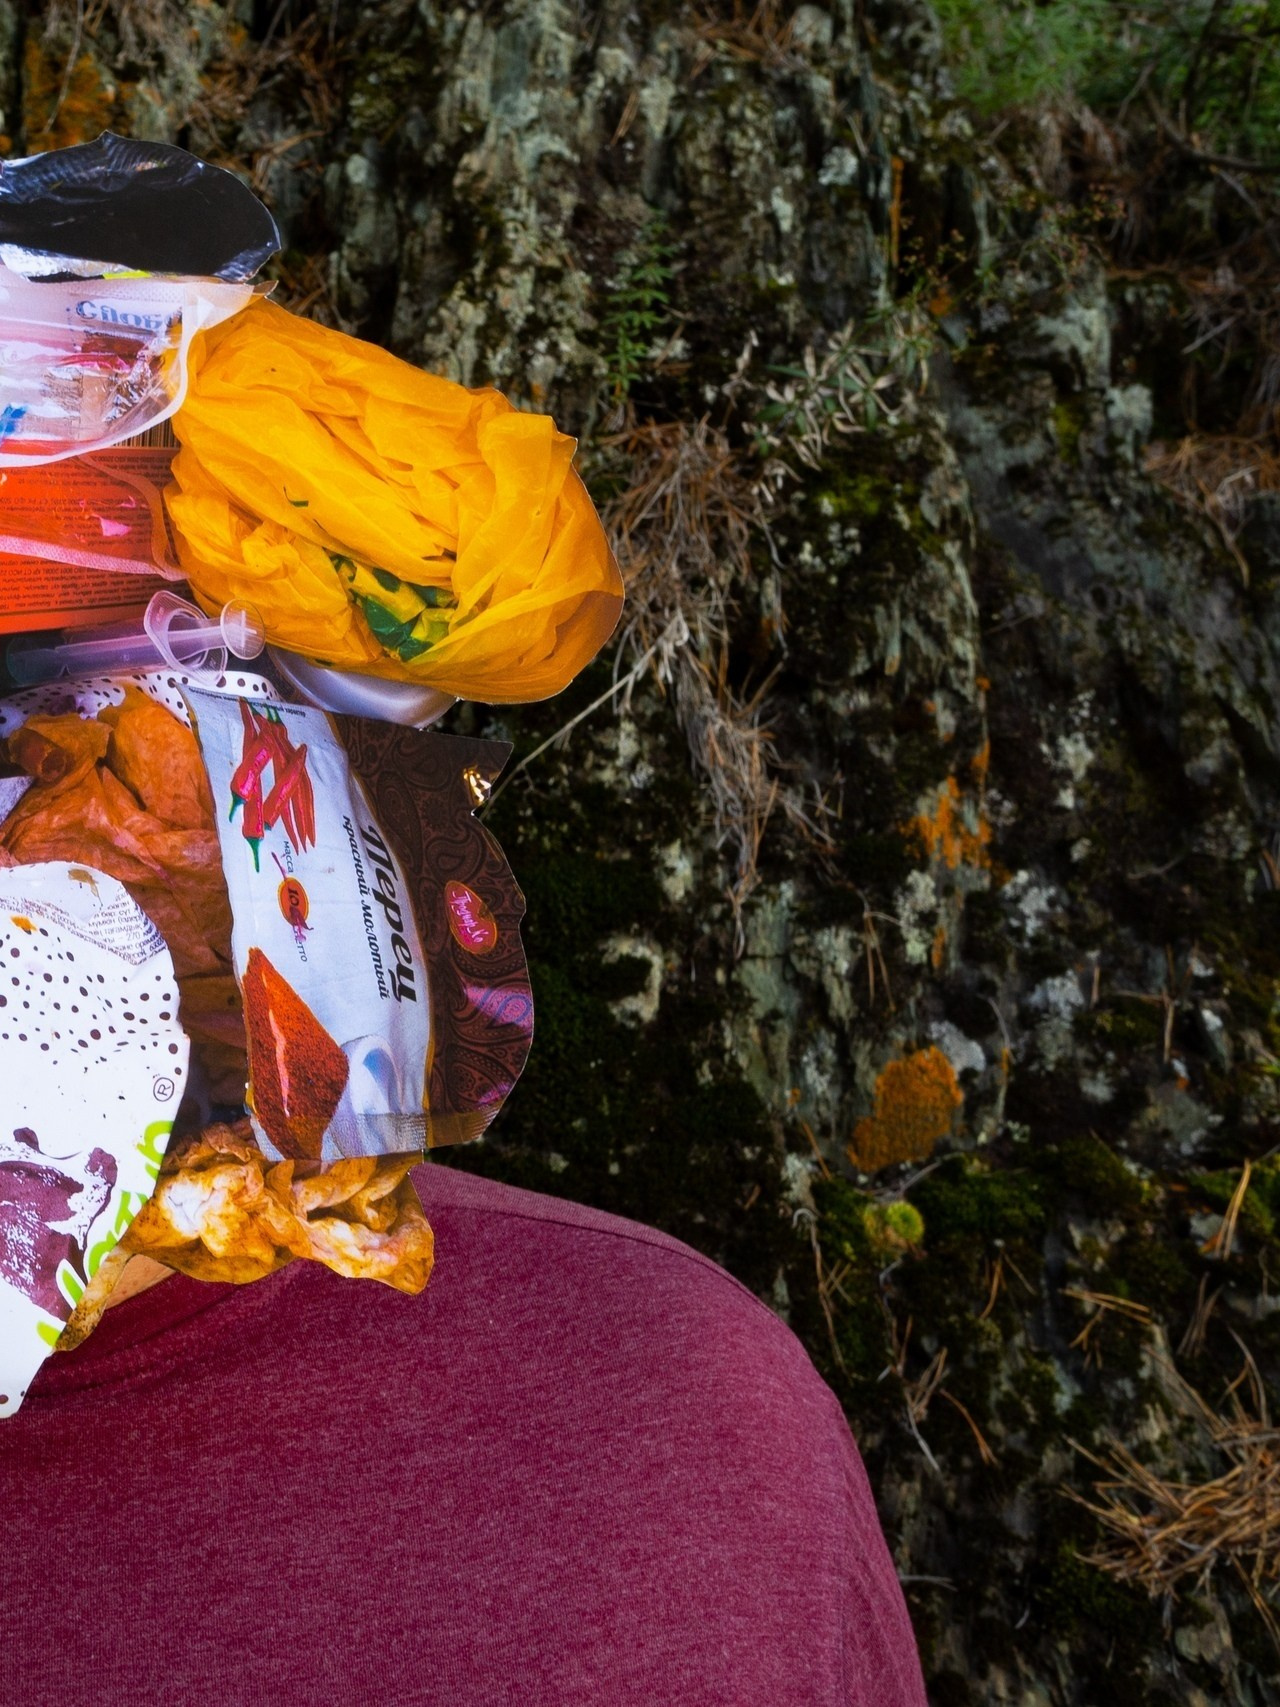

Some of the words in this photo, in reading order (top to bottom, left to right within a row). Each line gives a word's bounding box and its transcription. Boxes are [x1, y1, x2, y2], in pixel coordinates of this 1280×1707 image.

[282, 840, 295, 873] масса
[343, 815, 370, 898] красный
[360, 899, 389, 1001] молотый
[362, 823, 419, 1005] Перец
